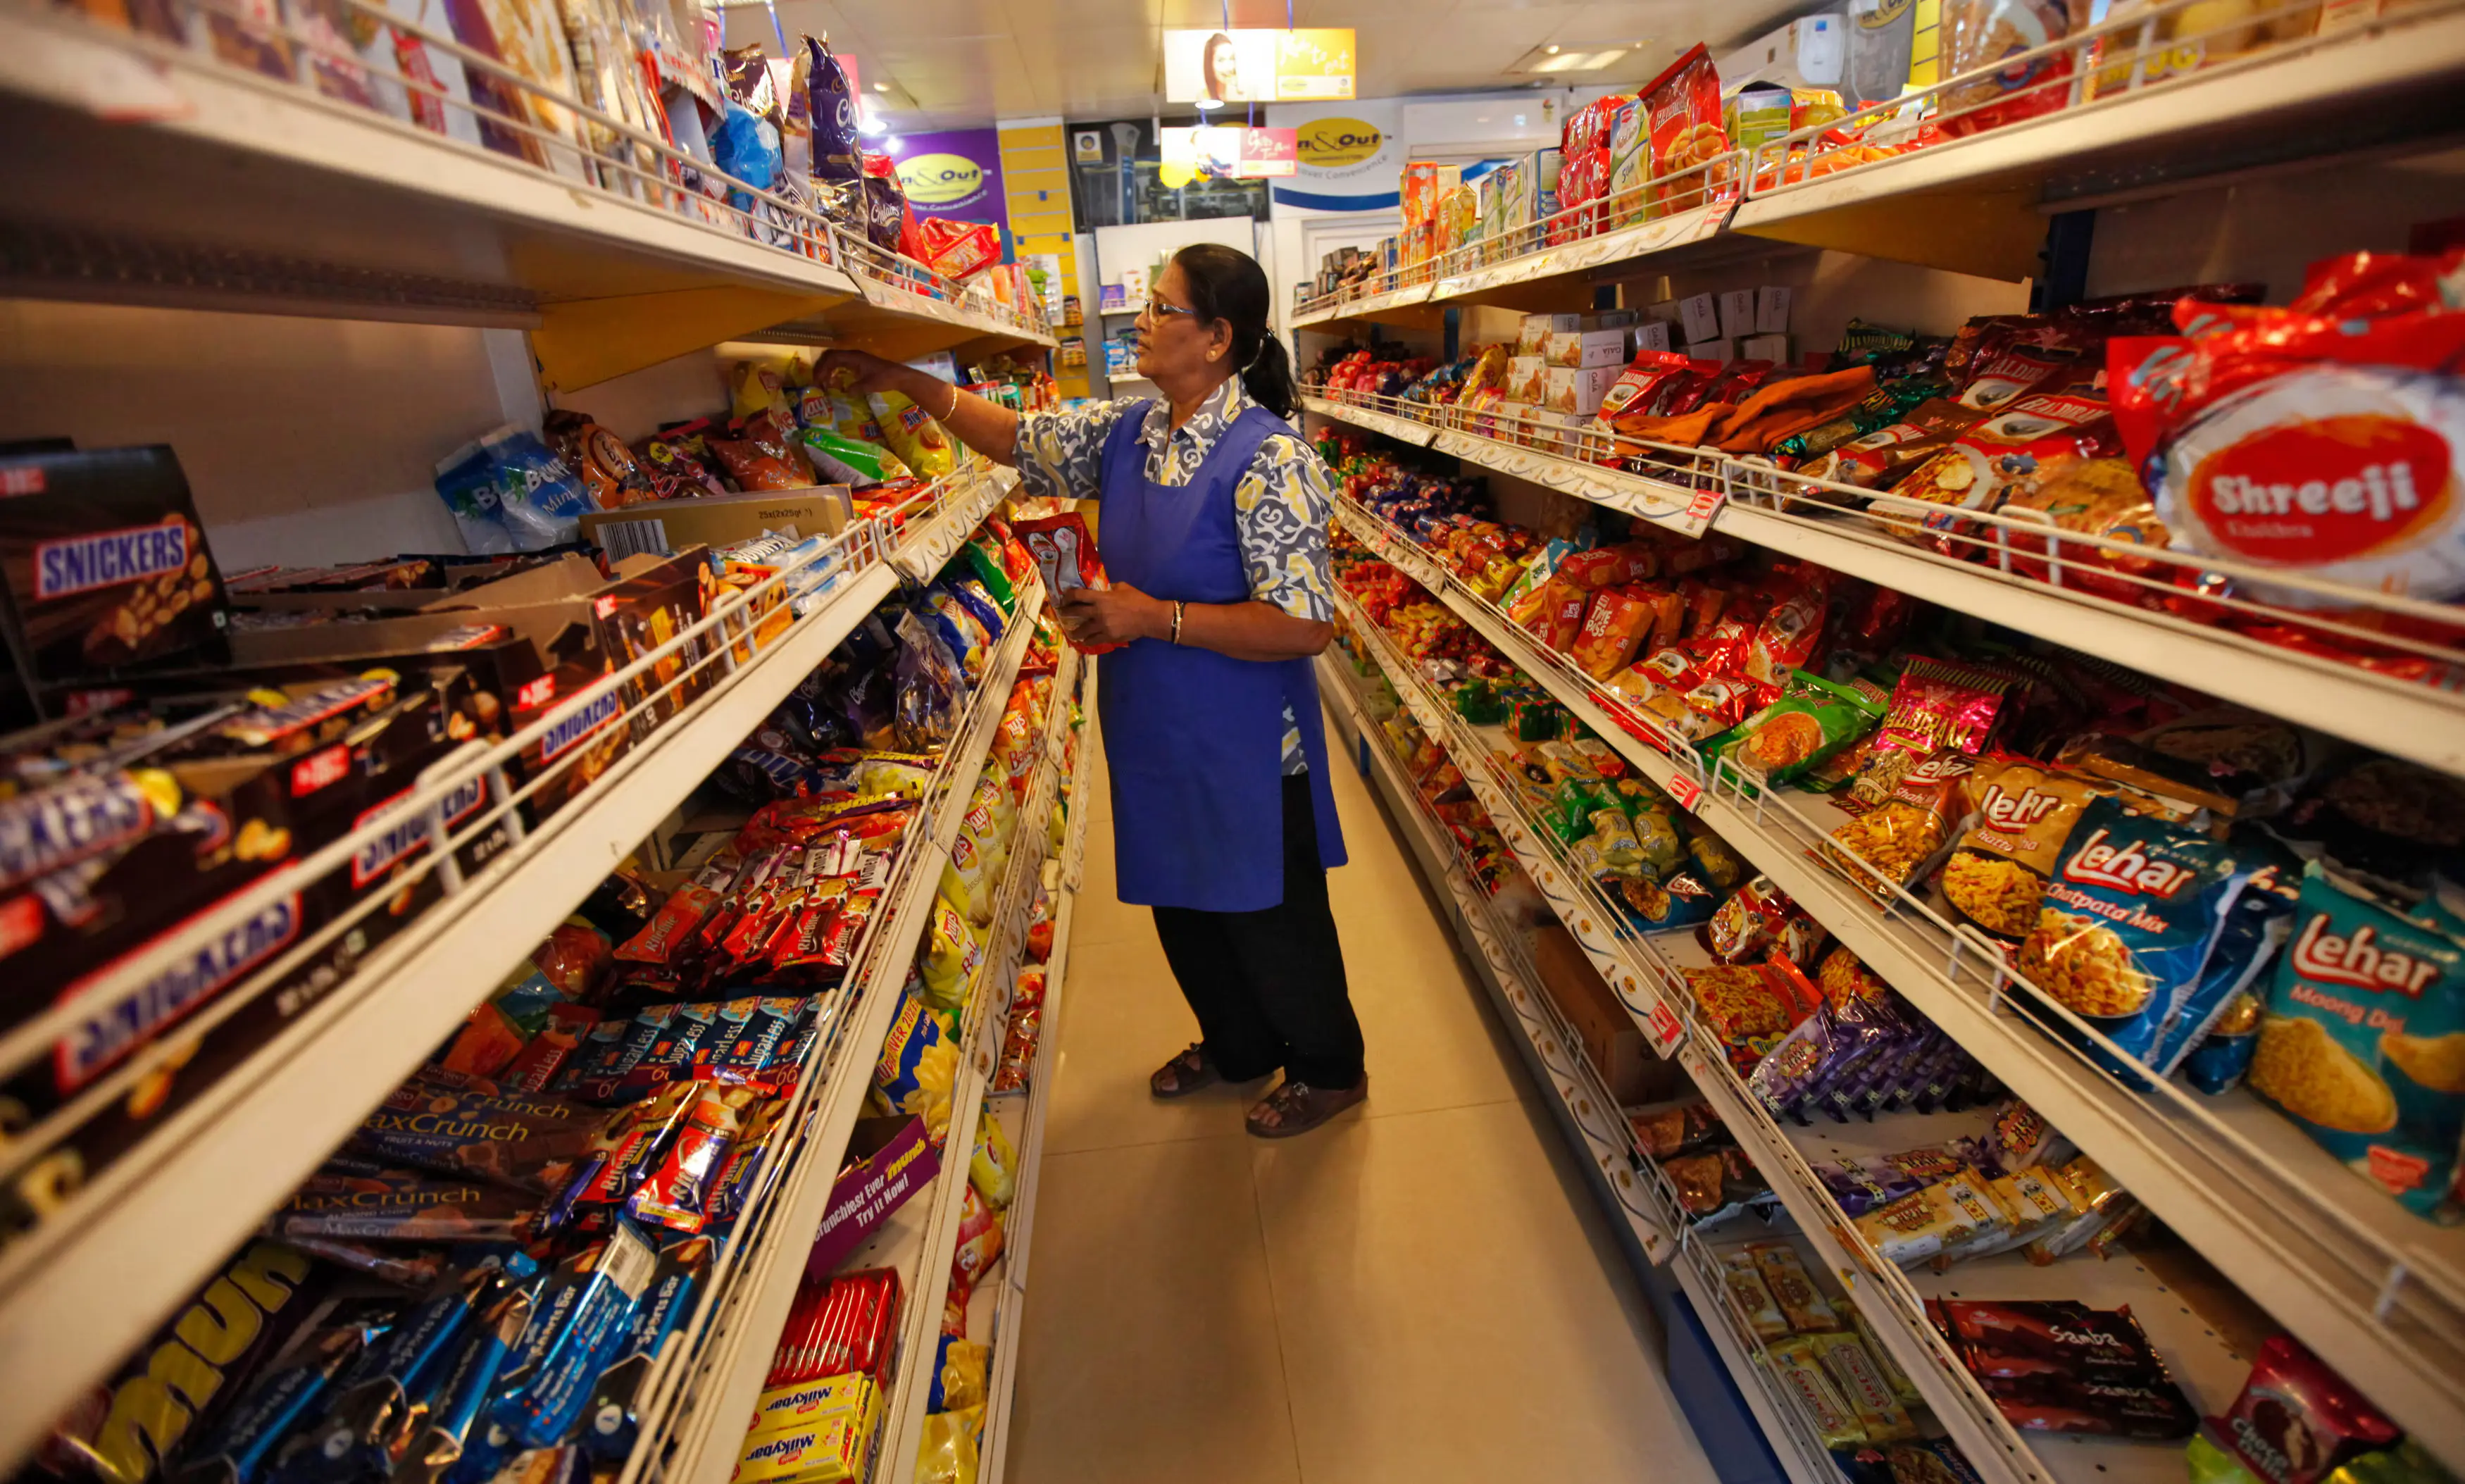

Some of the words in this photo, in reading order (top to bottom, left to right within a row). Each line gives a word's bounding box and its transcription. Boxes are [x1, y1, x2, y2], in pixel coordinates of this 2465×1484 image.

[1338, 134, 1381, 145] Out
[940, 169, 978, 181] Out
[2210, 461, 2419, 521] Shreeji
[42, 525, 185, 594] SNICKERS
[1585, 619, 1607, 637] PASS
[1591, 605, 1613, 625] TIME
[1882, 704, 1973, 749] ALDIRAM
[2064, 828, 2195, 898] Lehar
[2047, 882, 2128, 923] Chatpata
[2126, 909, 2170, 935] Mix
[797, 910, 821, 952] RiteBite
[2292, 913, 2439, 999] Lehar
[2289, 983, 2367, 1025] Moong
[855, 1208, 875, 1228] Try
[885, 1172, 910, 1206] Now!
[864, 1173, 885, 1200] Ever
[2049, 1325, 2122, 1347] Samba
[765, 1385, 832, 1411] Milkybar
[744, 1433, 816, 1461] Milkybar
